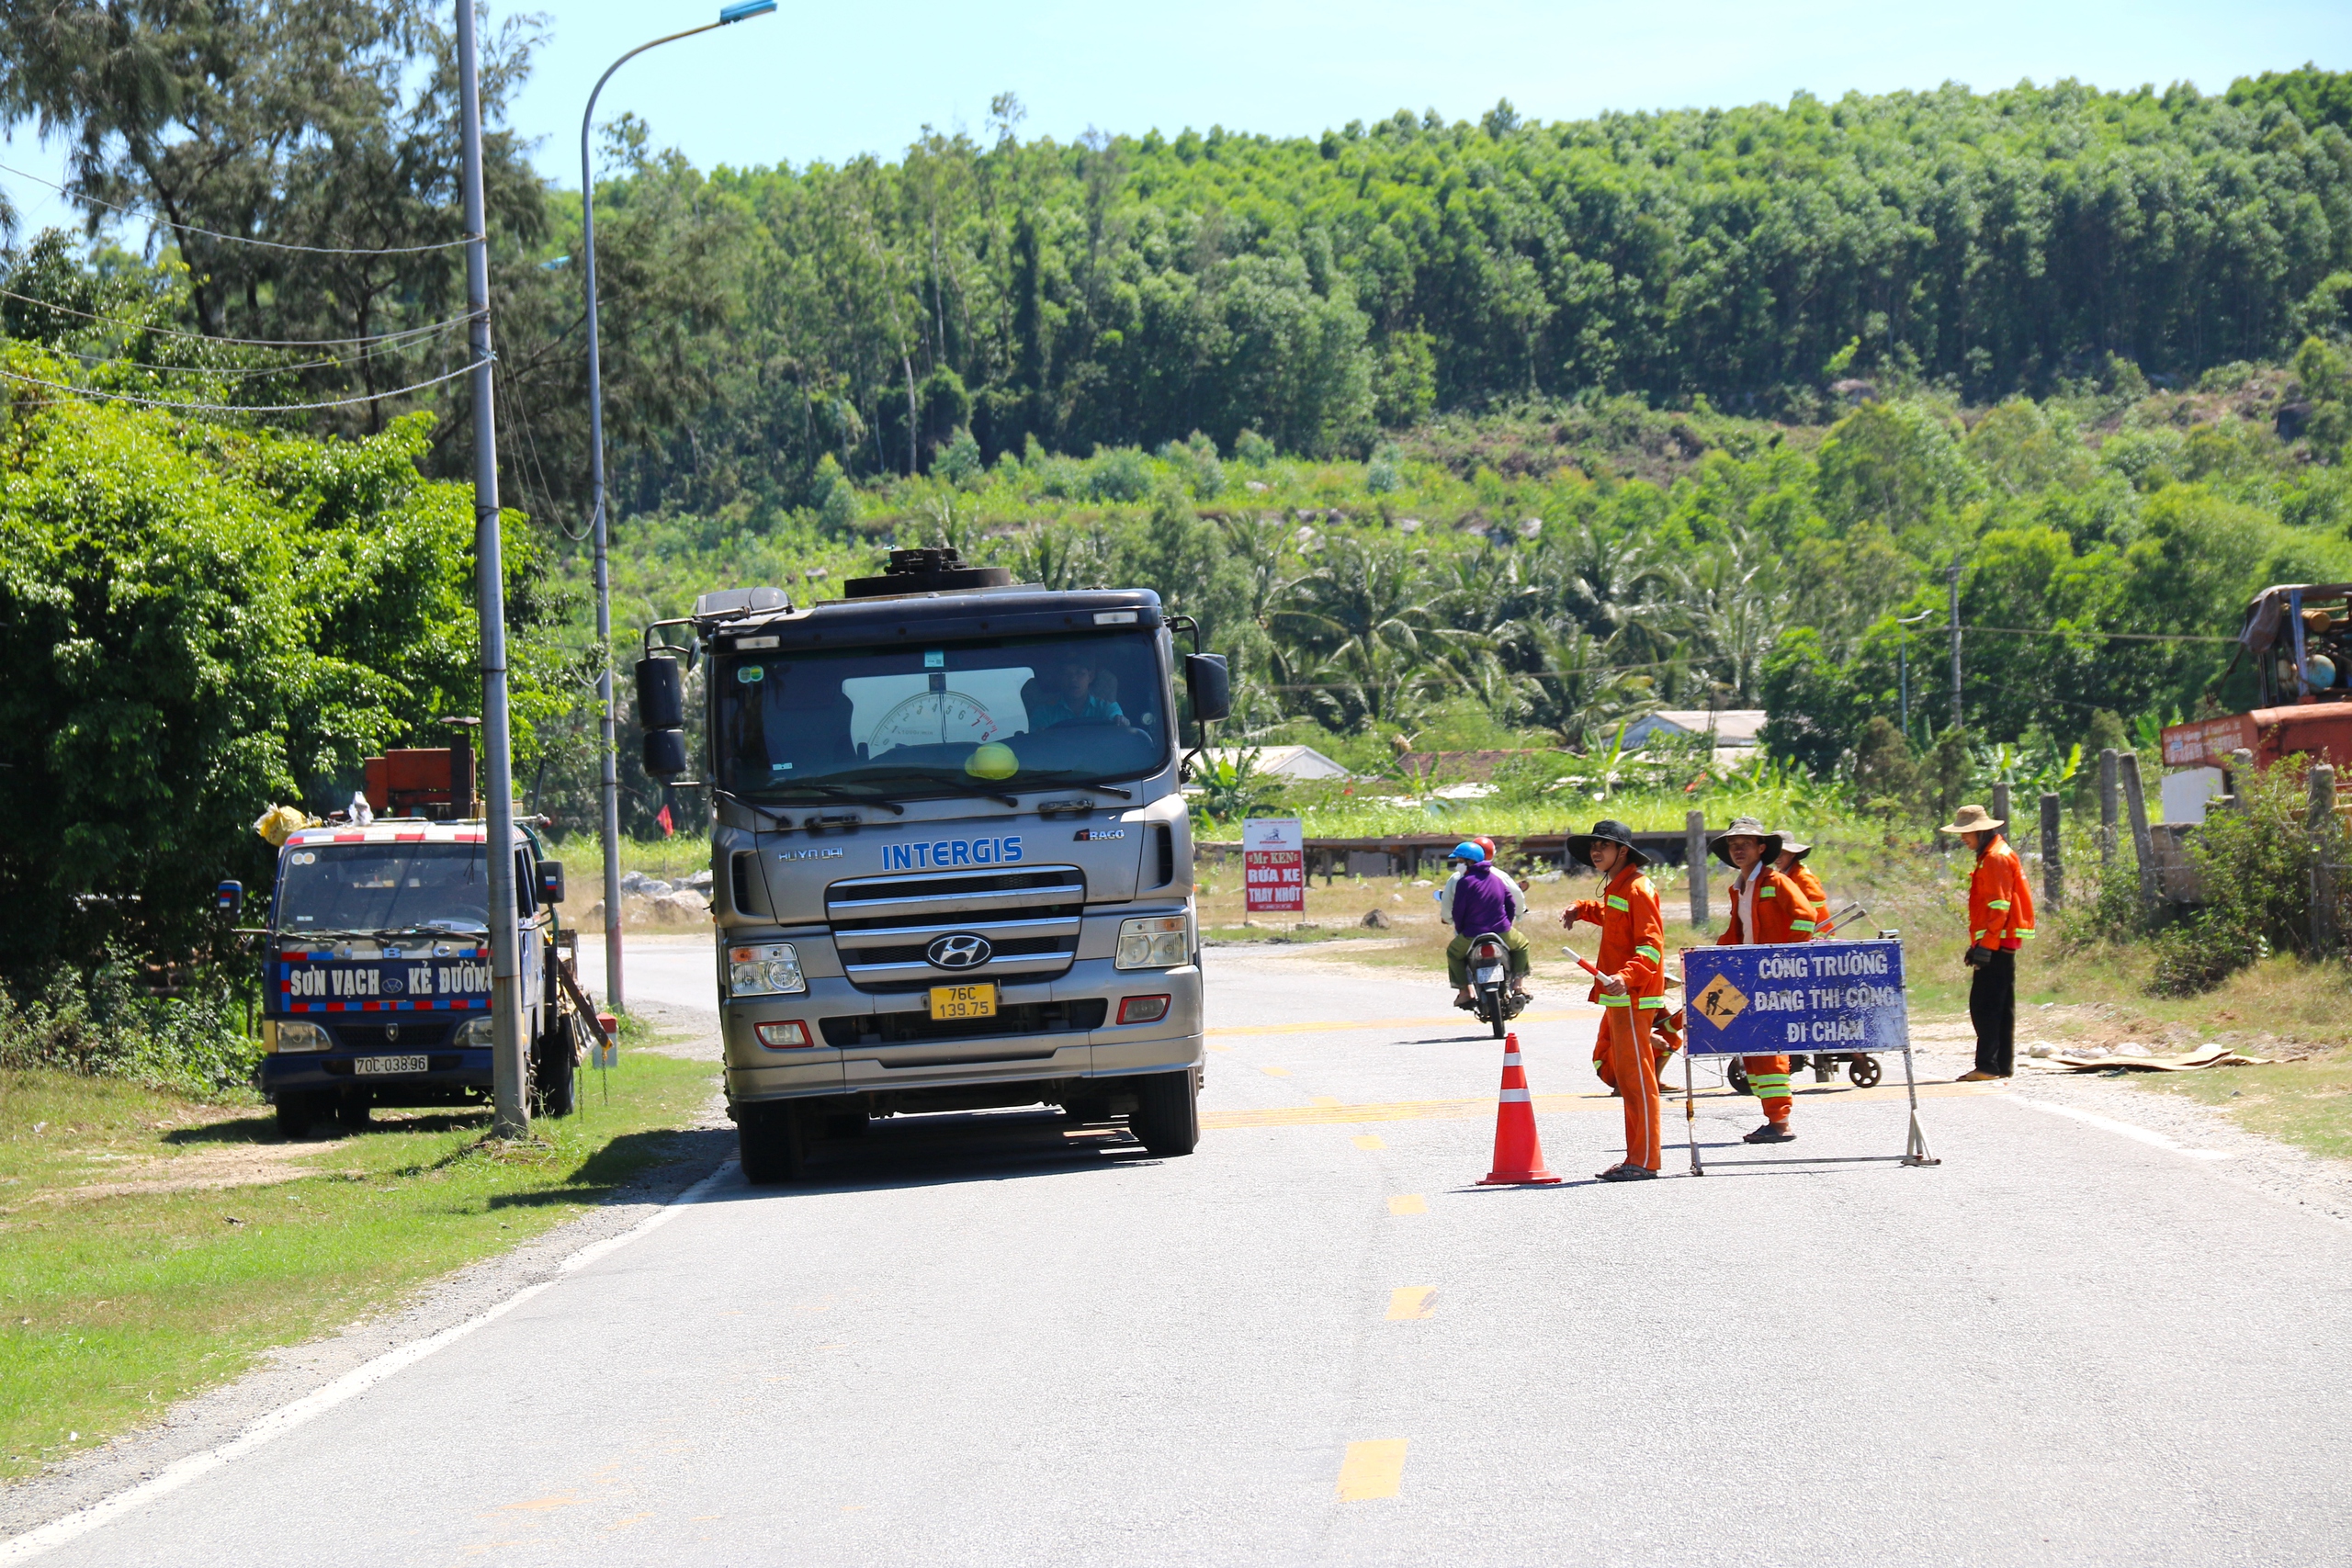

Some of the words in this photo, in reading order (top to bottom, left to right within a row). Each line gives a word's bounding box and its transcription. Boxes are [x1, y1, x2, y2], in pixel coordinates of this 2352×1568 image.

[1080, 829, 1125, 841] TRAGO
[881, 835, 1023, 872] INTERGIS
[1253, 852, 1269, 864] Mr
[1271, 852, 1295, 864] KEN
[1283, 868, 1301, 882] XE
[1249, 887, 1273, 902] THAY
[1758, 953, 1808, 978] CÔNG
[1813, 950, 1889, 976] TRƯỜNG
[290, 964, 326, 996] SƠN
[331, 968, 380, 998] VẠCH
[408, 960, 433, 995] KẺ
[948, 987, 977, 1001] 76C
[1755, 989, 1805, 1011] ĐANG
[1809, 988, 1840, 1010] THI
[1846, 982, 1895, 1009] CÔNG
[940, 1001, 989, 1017] 139.75
[1787, 1022, 1807, 1043] ĐI
[357, 1057, 425, 1073] 70C-038.96
